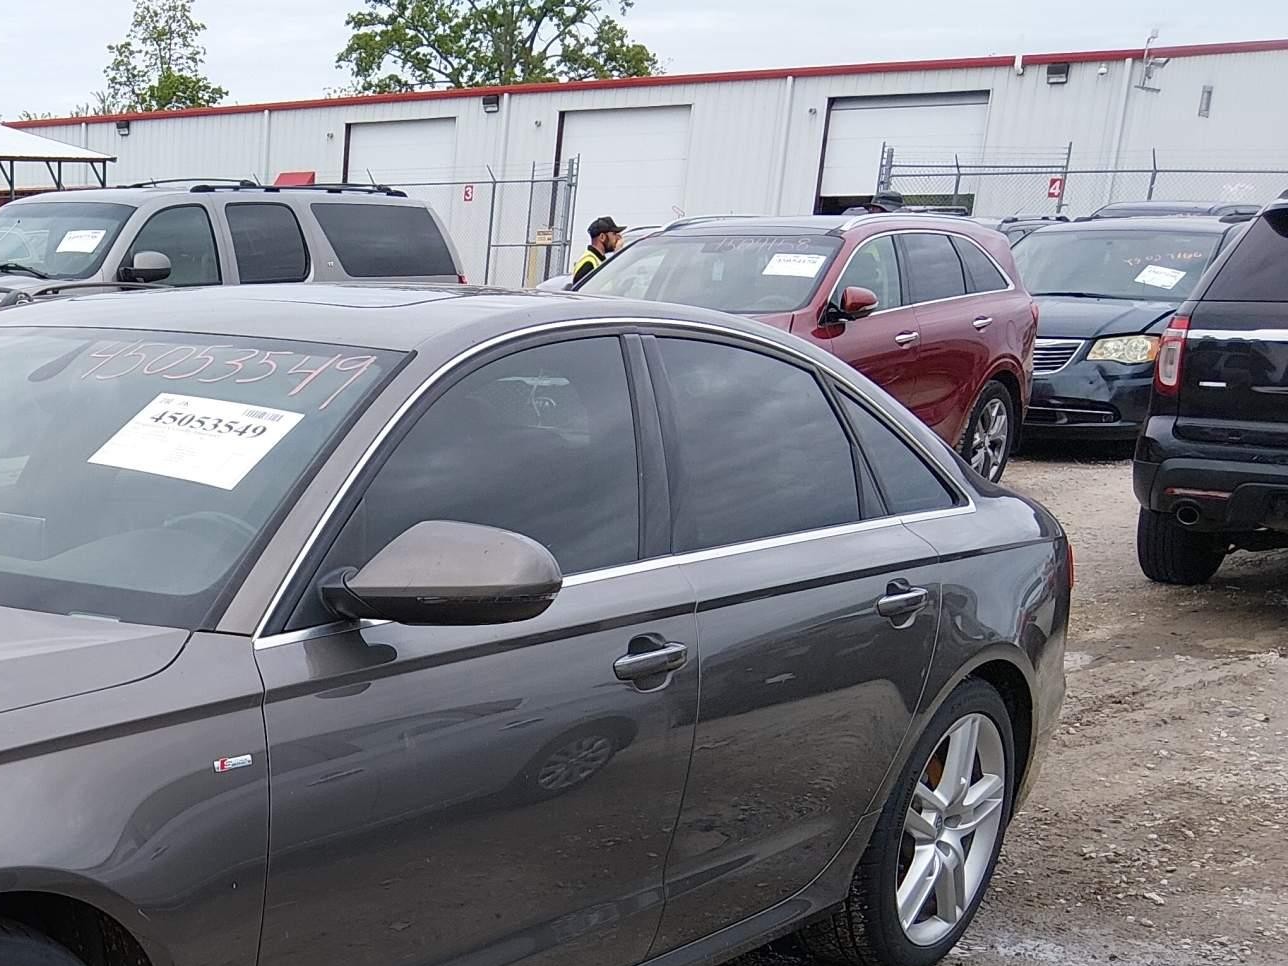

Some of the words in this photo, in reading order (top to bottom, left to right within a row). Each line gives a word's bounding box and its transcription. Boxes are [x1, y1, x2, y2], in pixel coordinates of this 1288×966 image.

[464, 186, 473, 200] 3
[1049, 179, 1061, 196] 4
[81, 338, 377, 411] 45053549
[149, 410, 267, 439] 45053549
